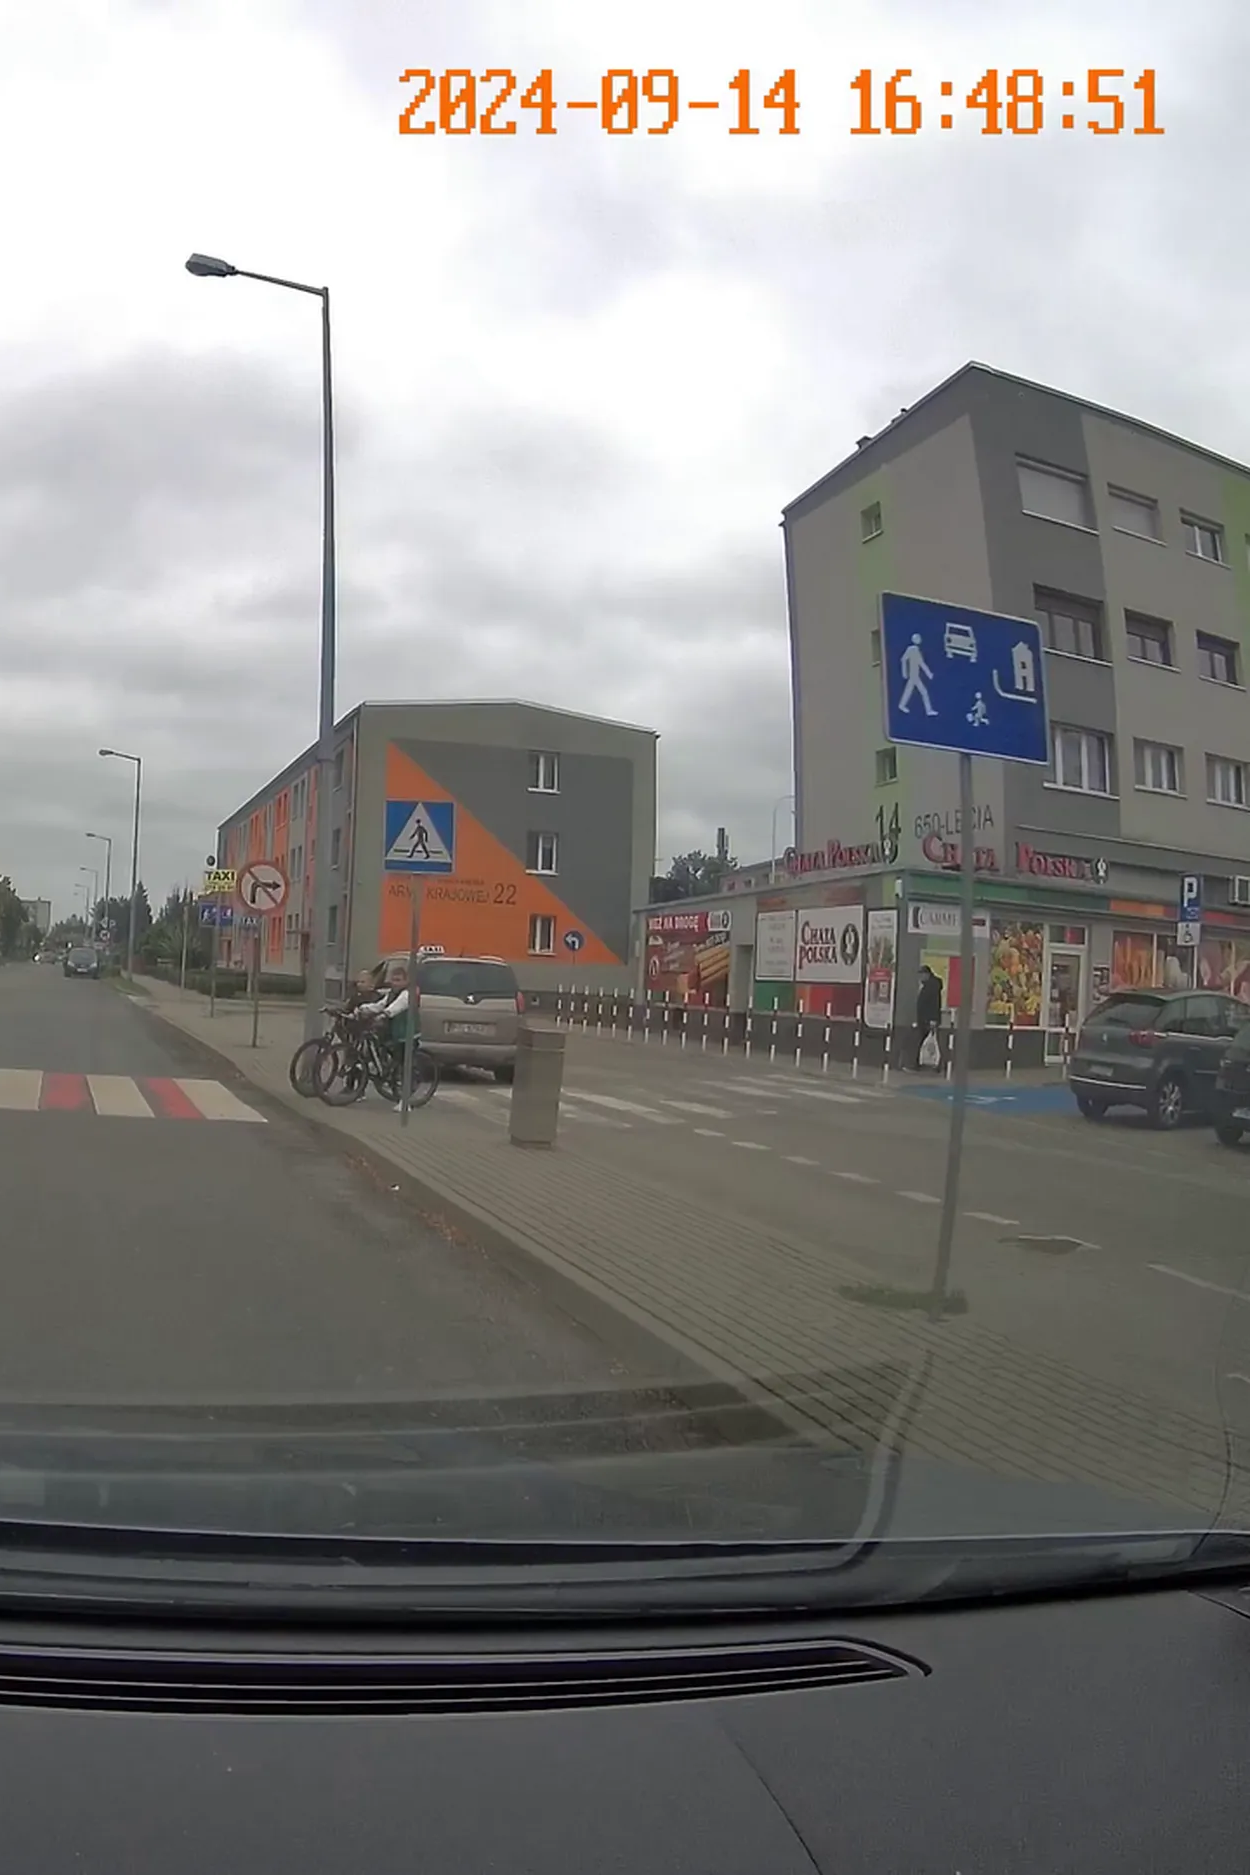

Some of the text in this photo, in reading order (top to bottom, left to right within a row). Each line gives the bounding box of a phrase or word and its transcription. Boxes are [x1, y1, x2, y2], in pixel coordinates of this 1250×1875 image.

[875, 802, 901, 843] 14
[204, 871, 235, 881] TAXI
[493, 882, 517, 905] 22
[1183, 875, 1198, 908] P
